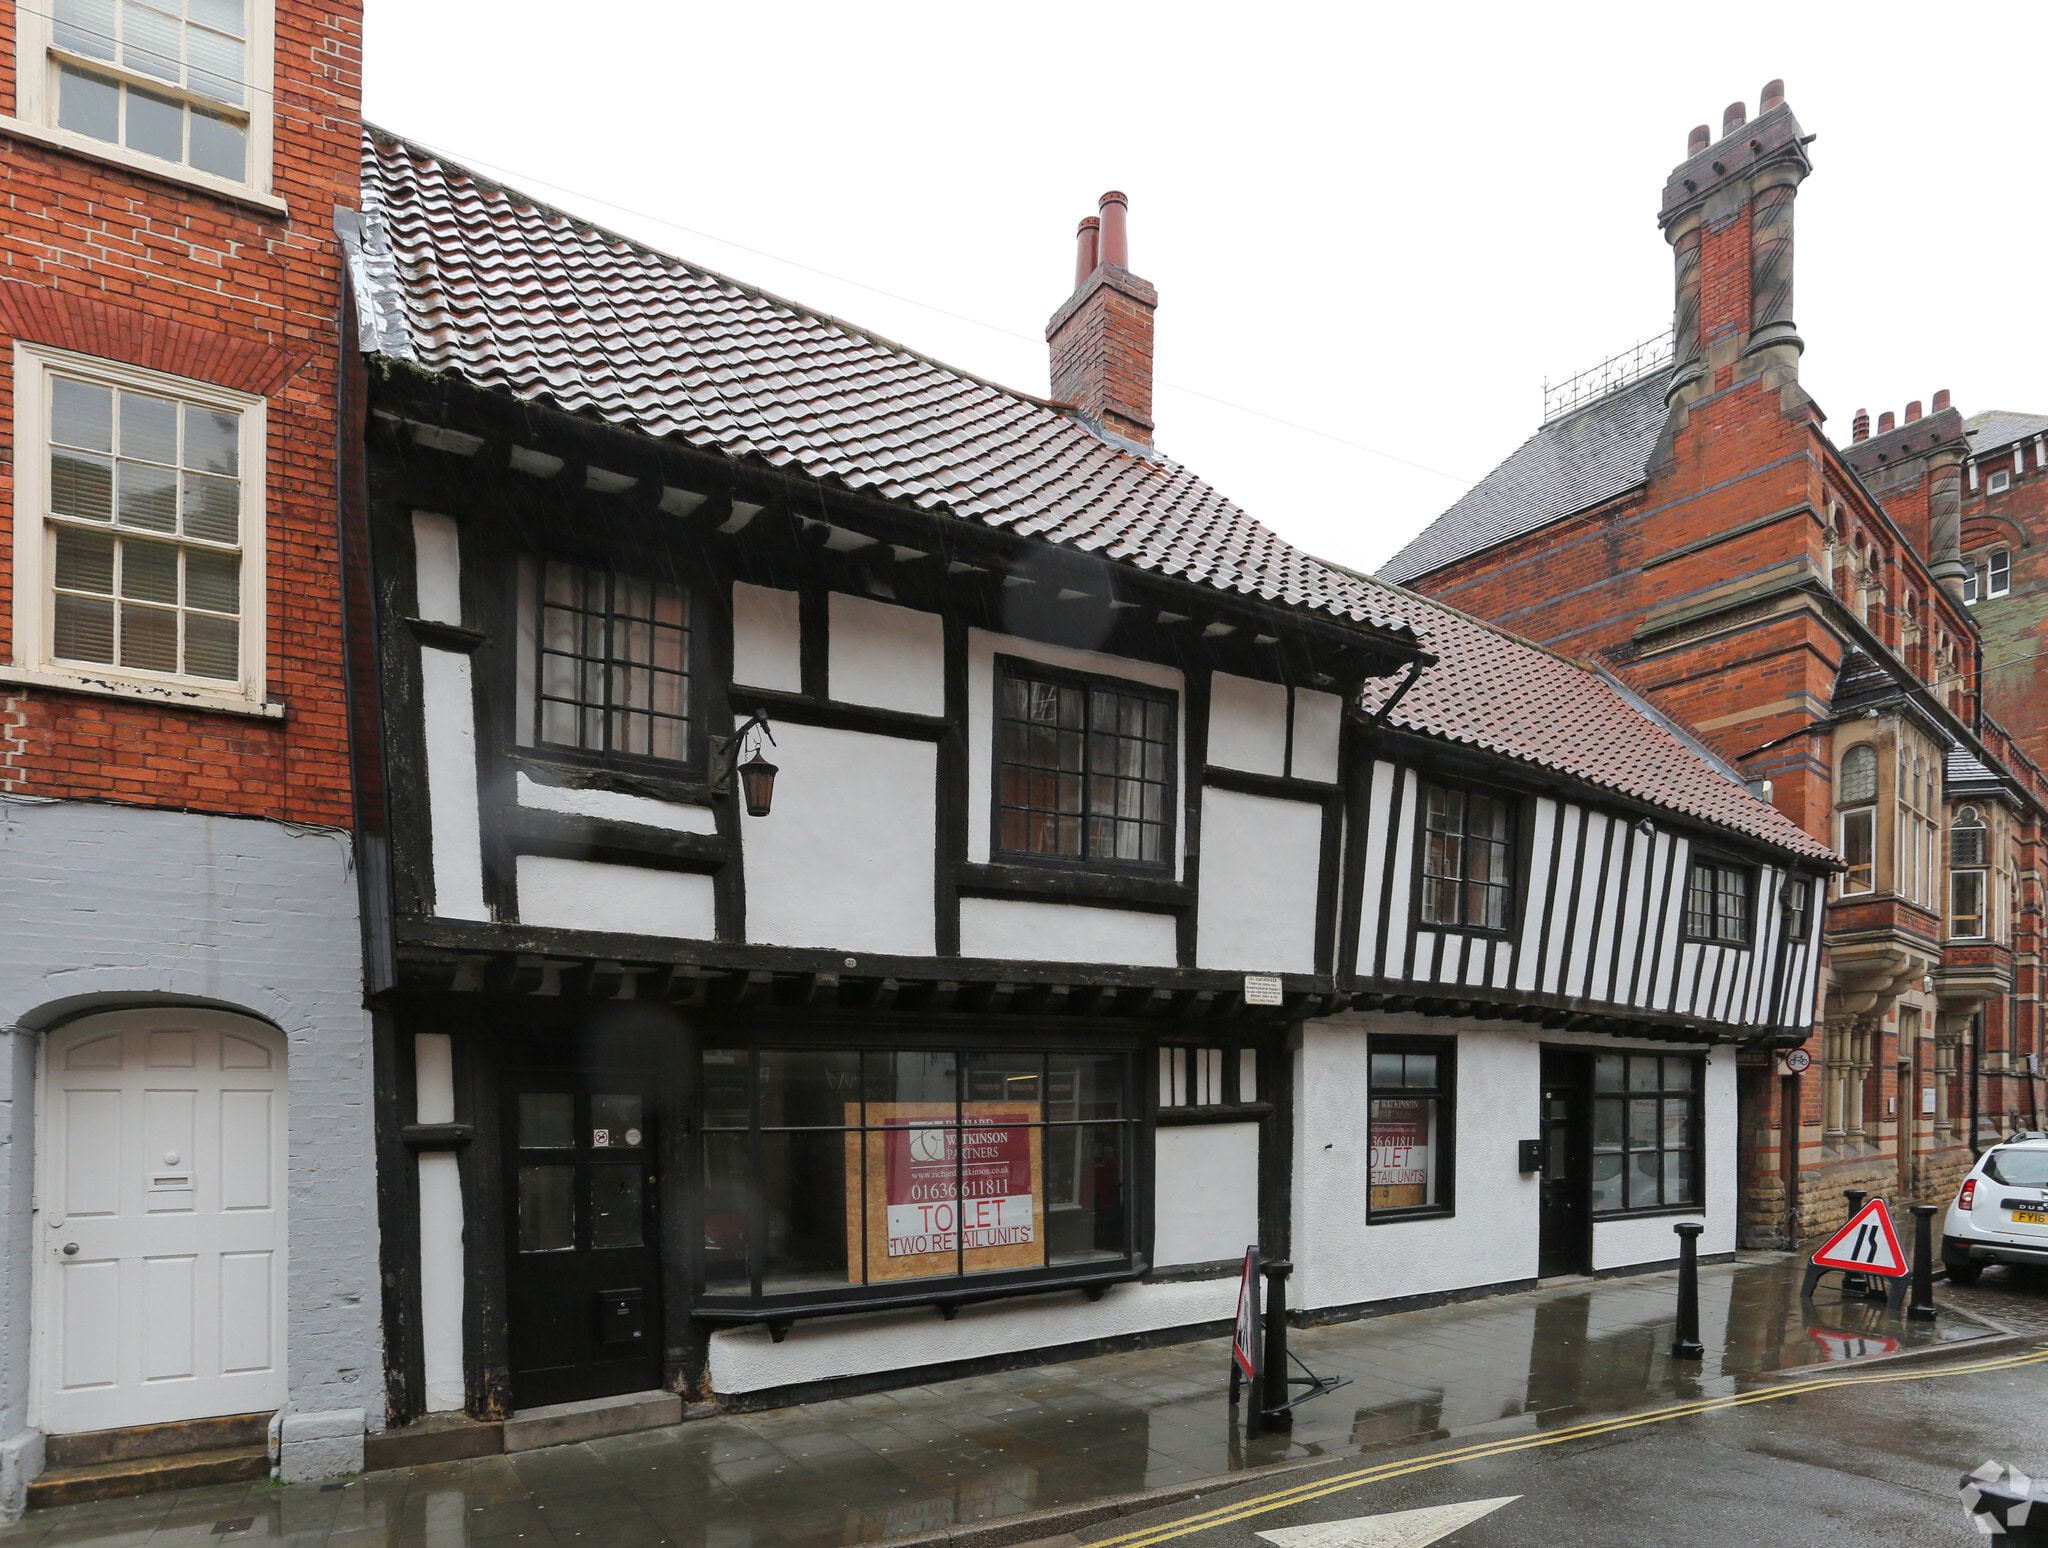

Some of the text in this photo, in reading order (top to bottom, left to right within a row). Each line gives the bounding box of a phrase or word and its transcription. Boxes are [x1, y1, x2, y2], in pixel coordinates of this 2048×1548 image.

[946, 1132, 1008, 1146] WTKINSON
[1383, 1147, 1412, 1168] LET
[911, 1166, 1009, 1179] www.richardatkinson.co.uk
[1398, 1169, 1425, 1183] UNITS
[911, 1179, 1009, 1200] 01636 611811
[918, 1200, 1006, 1233] TO LET
[890, 1226, 1030, 1255] TWO REAIL UNITS
